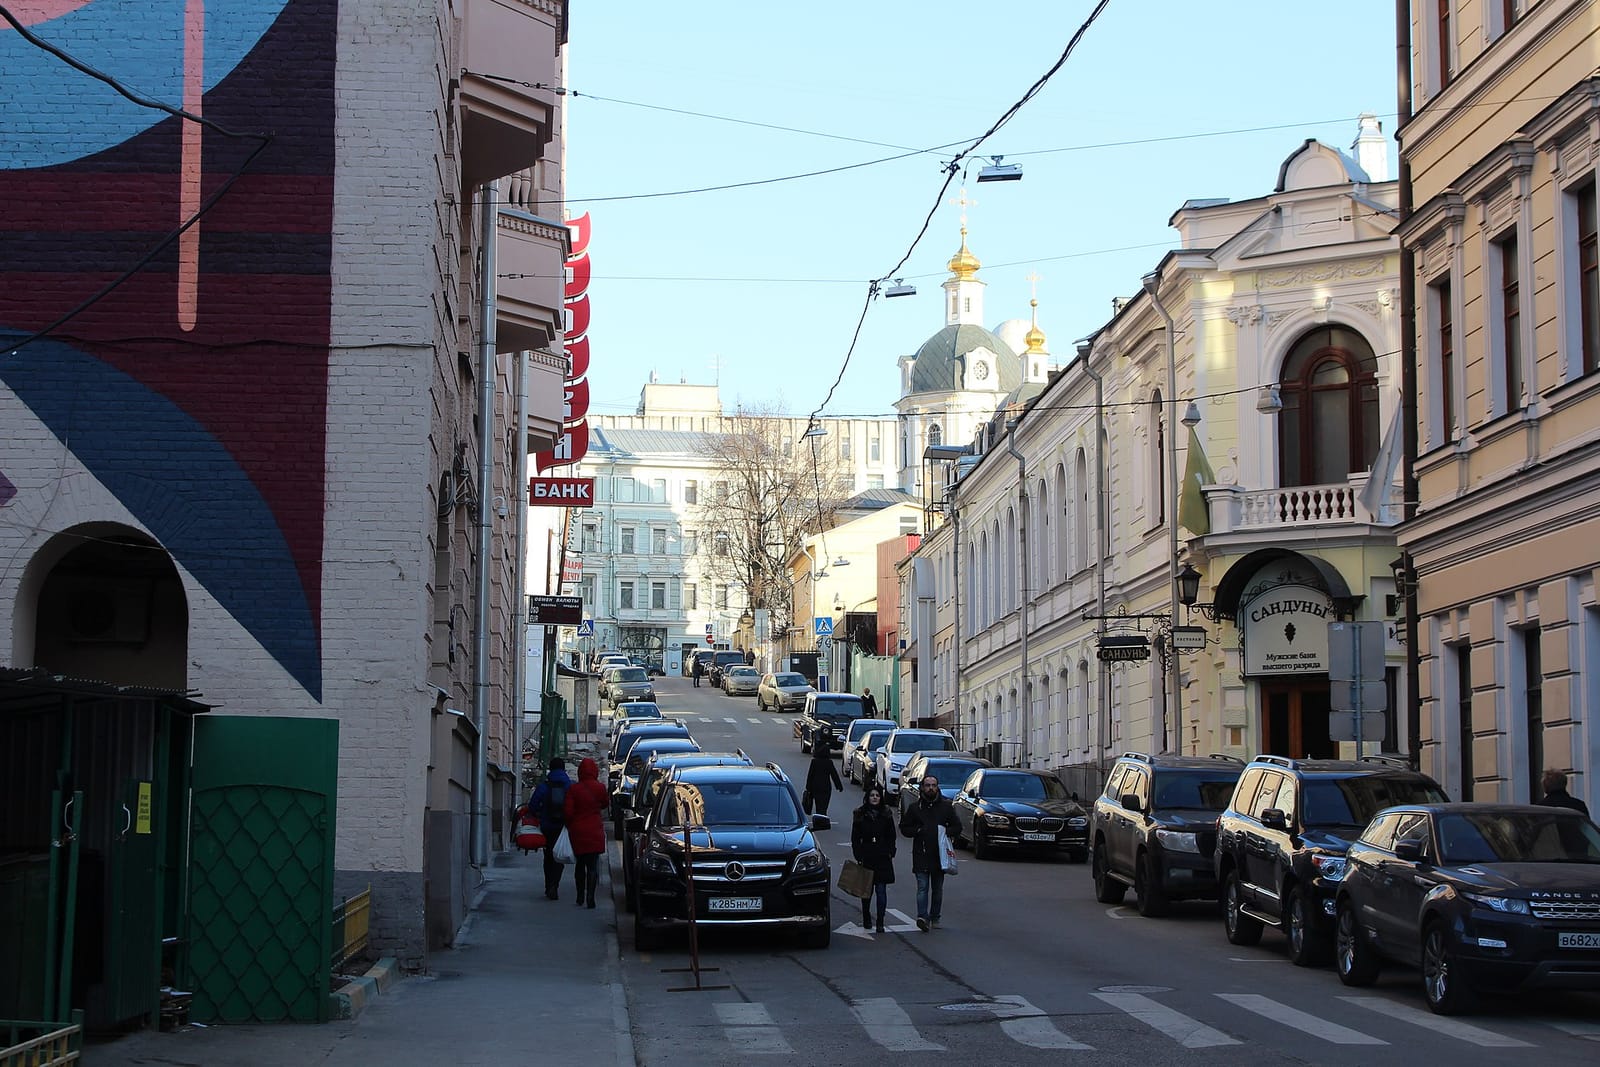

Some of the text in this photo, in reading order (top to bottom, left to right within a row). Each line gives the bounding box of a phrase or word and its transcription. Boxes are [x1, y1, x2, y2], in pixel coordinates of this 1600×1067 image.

[534, 483, 590, 498] БАНК
[1251, 600, 1329, 622] САНДУНЫ
[1101, 649, 1147, 660] САНДУНЫ
[1265, 651, 1317, 662] Мужские бани
[1293, 662, 1321, 670] разряда
